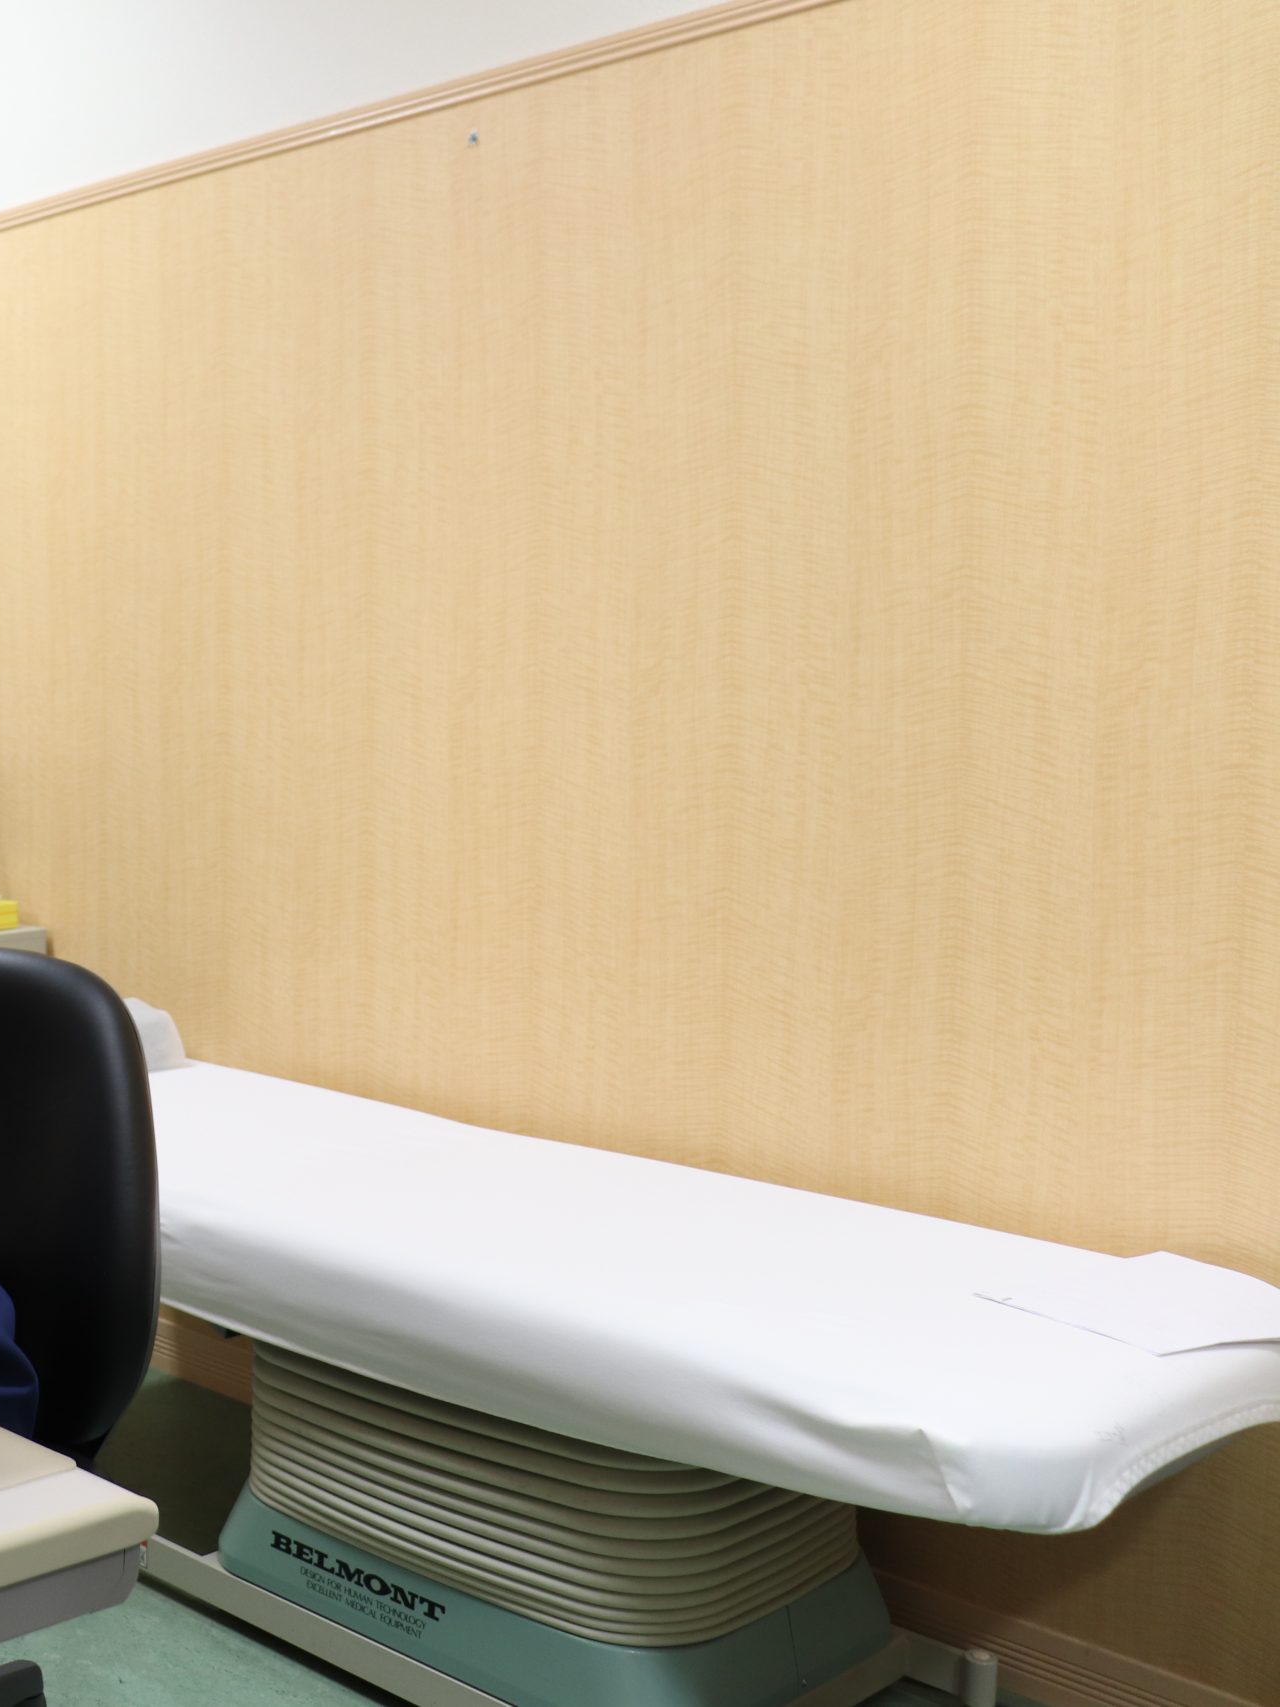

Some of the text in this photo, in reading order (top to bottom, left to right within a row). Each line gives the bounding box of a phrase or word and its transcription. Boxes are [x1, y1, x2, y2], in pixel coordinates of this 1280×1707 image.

[270, 1530, 446, 1622] BELMONT
[300, 1566, 426, 1630] DESIGN FOR HUMAN TECHNOLOGY
[306, 1579, 423, 1639] EXCELLENT MEDICAL EQUIPMENT
